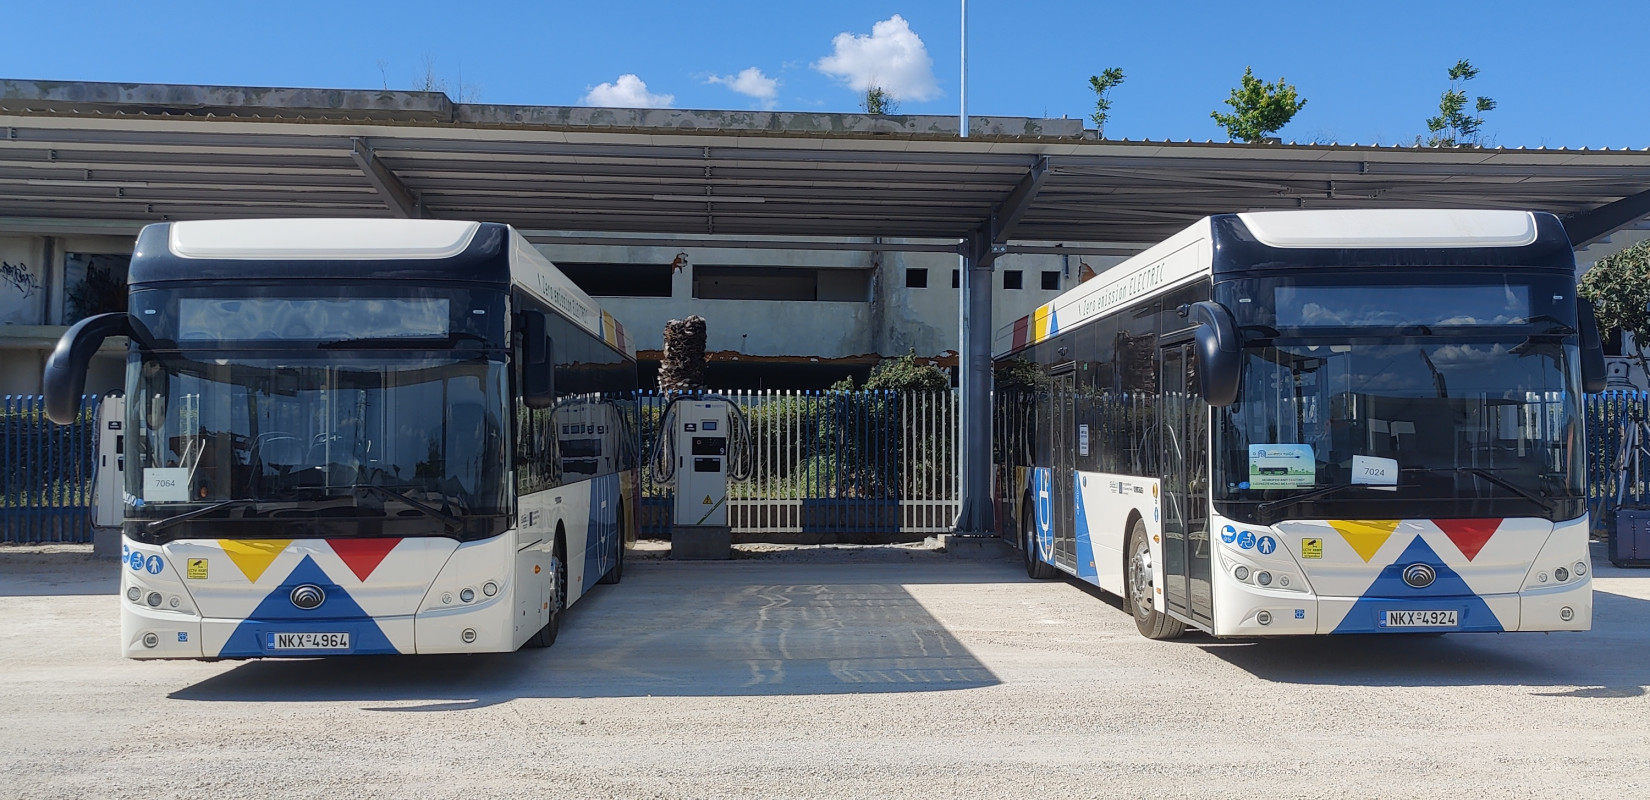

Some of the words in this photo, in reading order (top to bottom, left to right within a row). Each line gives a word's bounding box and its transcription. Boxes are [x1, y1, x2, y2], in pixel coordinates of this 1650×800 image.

[1083, 300, 1096, 316] Zero
[1098, 284, 1127, 310] emission
[1129, 263, 1165, 296] ELECTRIC
[1364, 467, 1386, 476] 7024
[156, 479, 176, 488] 7064
